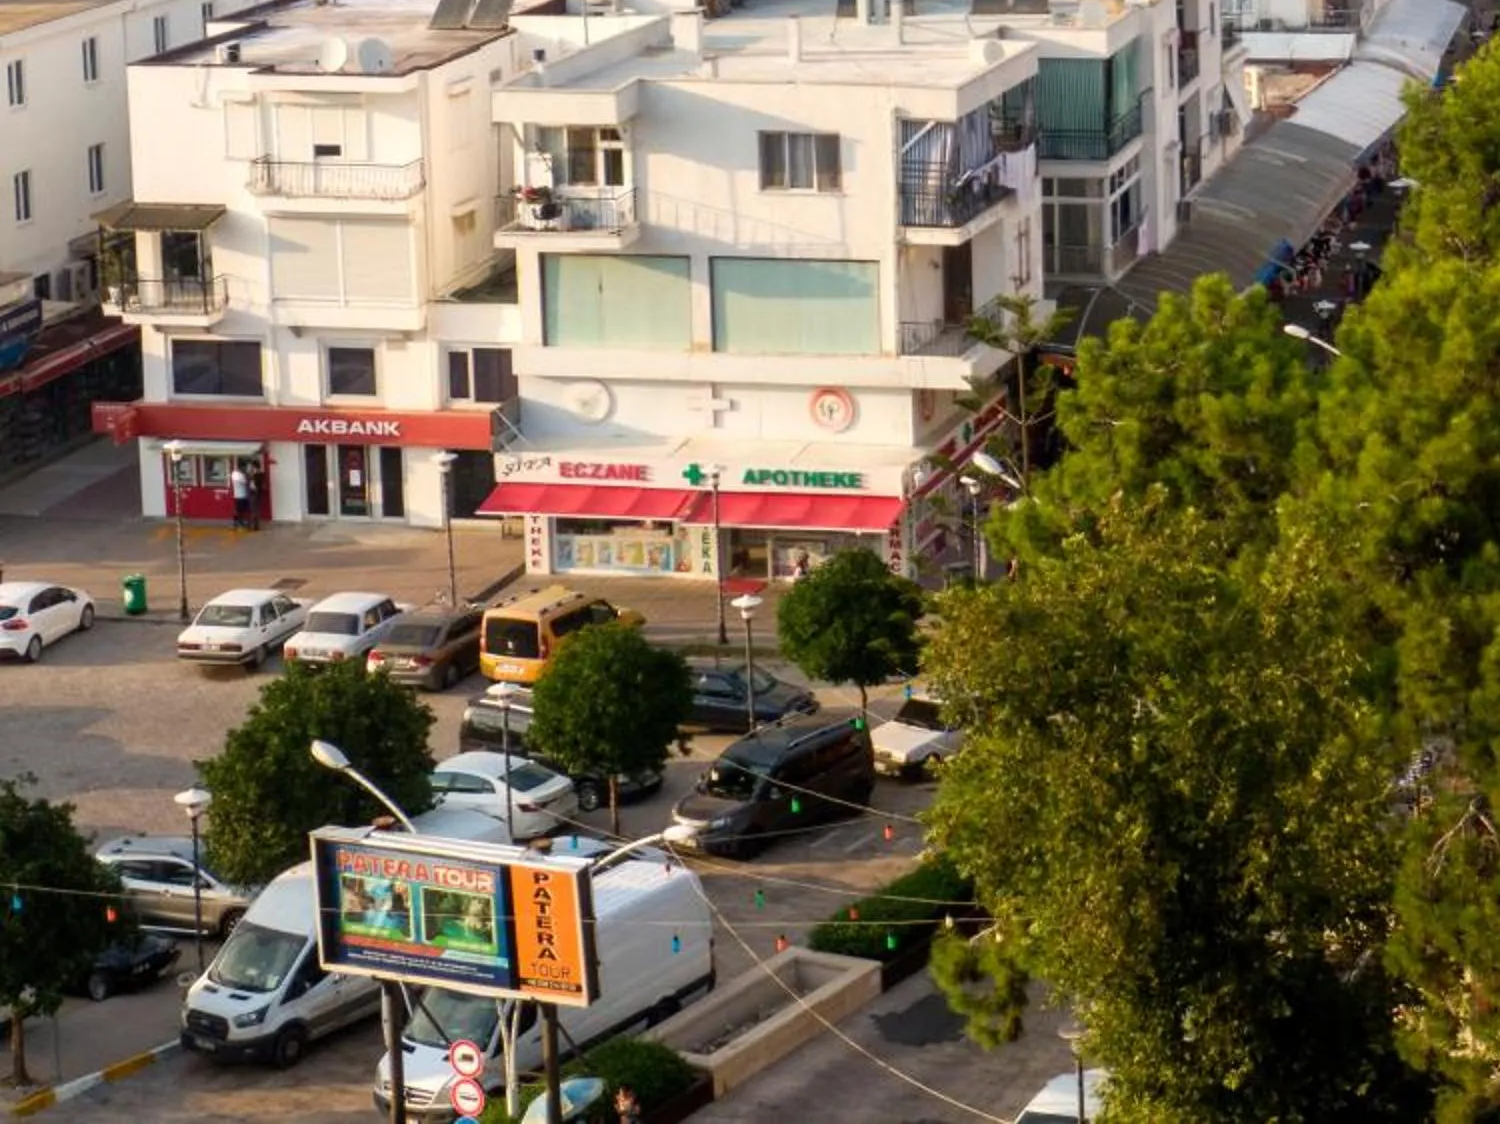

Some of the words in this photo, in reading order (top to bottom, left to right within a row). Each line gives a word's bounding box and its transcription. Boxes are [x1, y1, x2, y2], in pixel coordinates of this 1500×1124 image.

[297, 419, 400, 437] AKBANK
[558, 462, 651, 481] ECZANE
[742, 469, 866, 489] APOTHEKE
[336, 851, 430, 881] PATERA
[432, 864, 496, 893] TOUR
[533, 872, 557, 961] PATERA
[531, 962, 570, 978] TOUR
